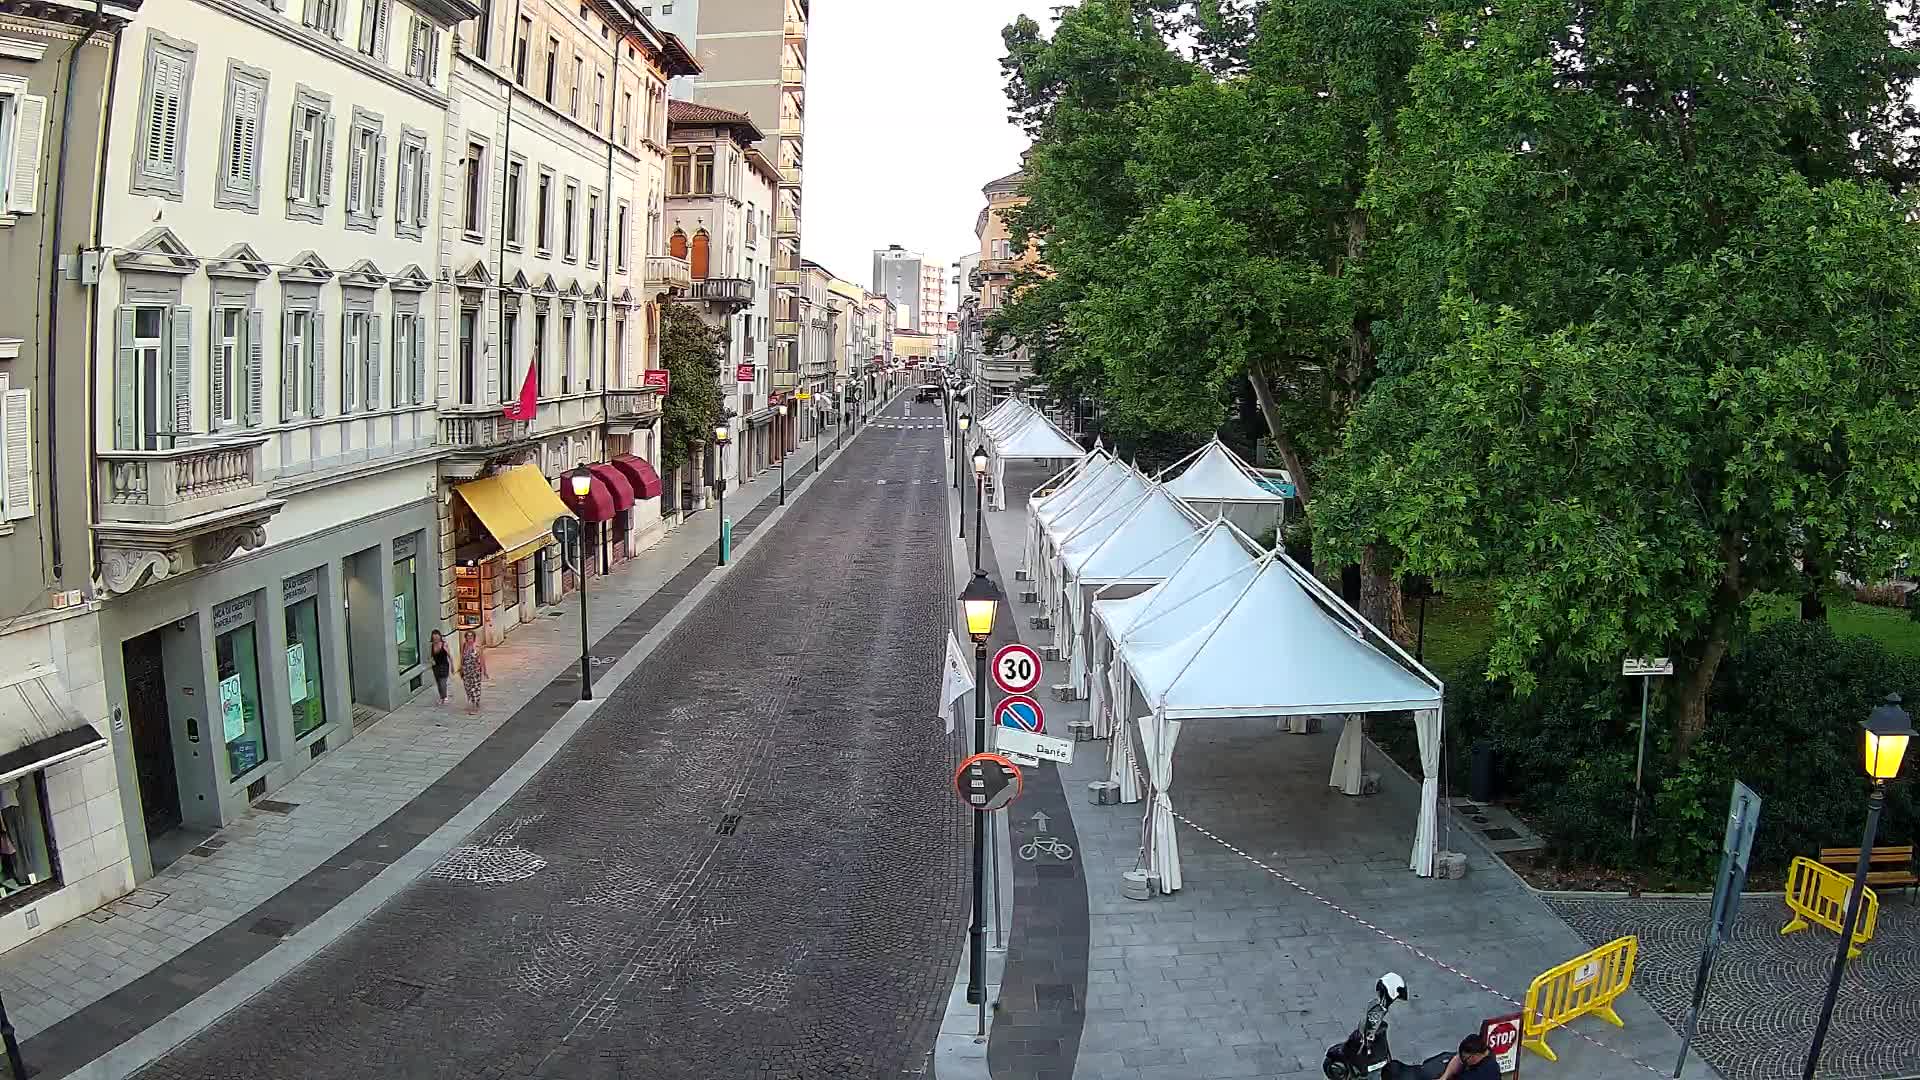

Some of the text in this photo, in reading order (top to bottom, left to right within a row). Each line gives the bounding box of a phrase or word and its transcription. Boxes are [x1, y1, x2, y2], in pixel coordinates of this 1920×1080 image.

[1003, 658, 1032, 681] 30
[1036, 743, 1067, 759] Dante
[1489, 1030, 1516, 1049] STOP
